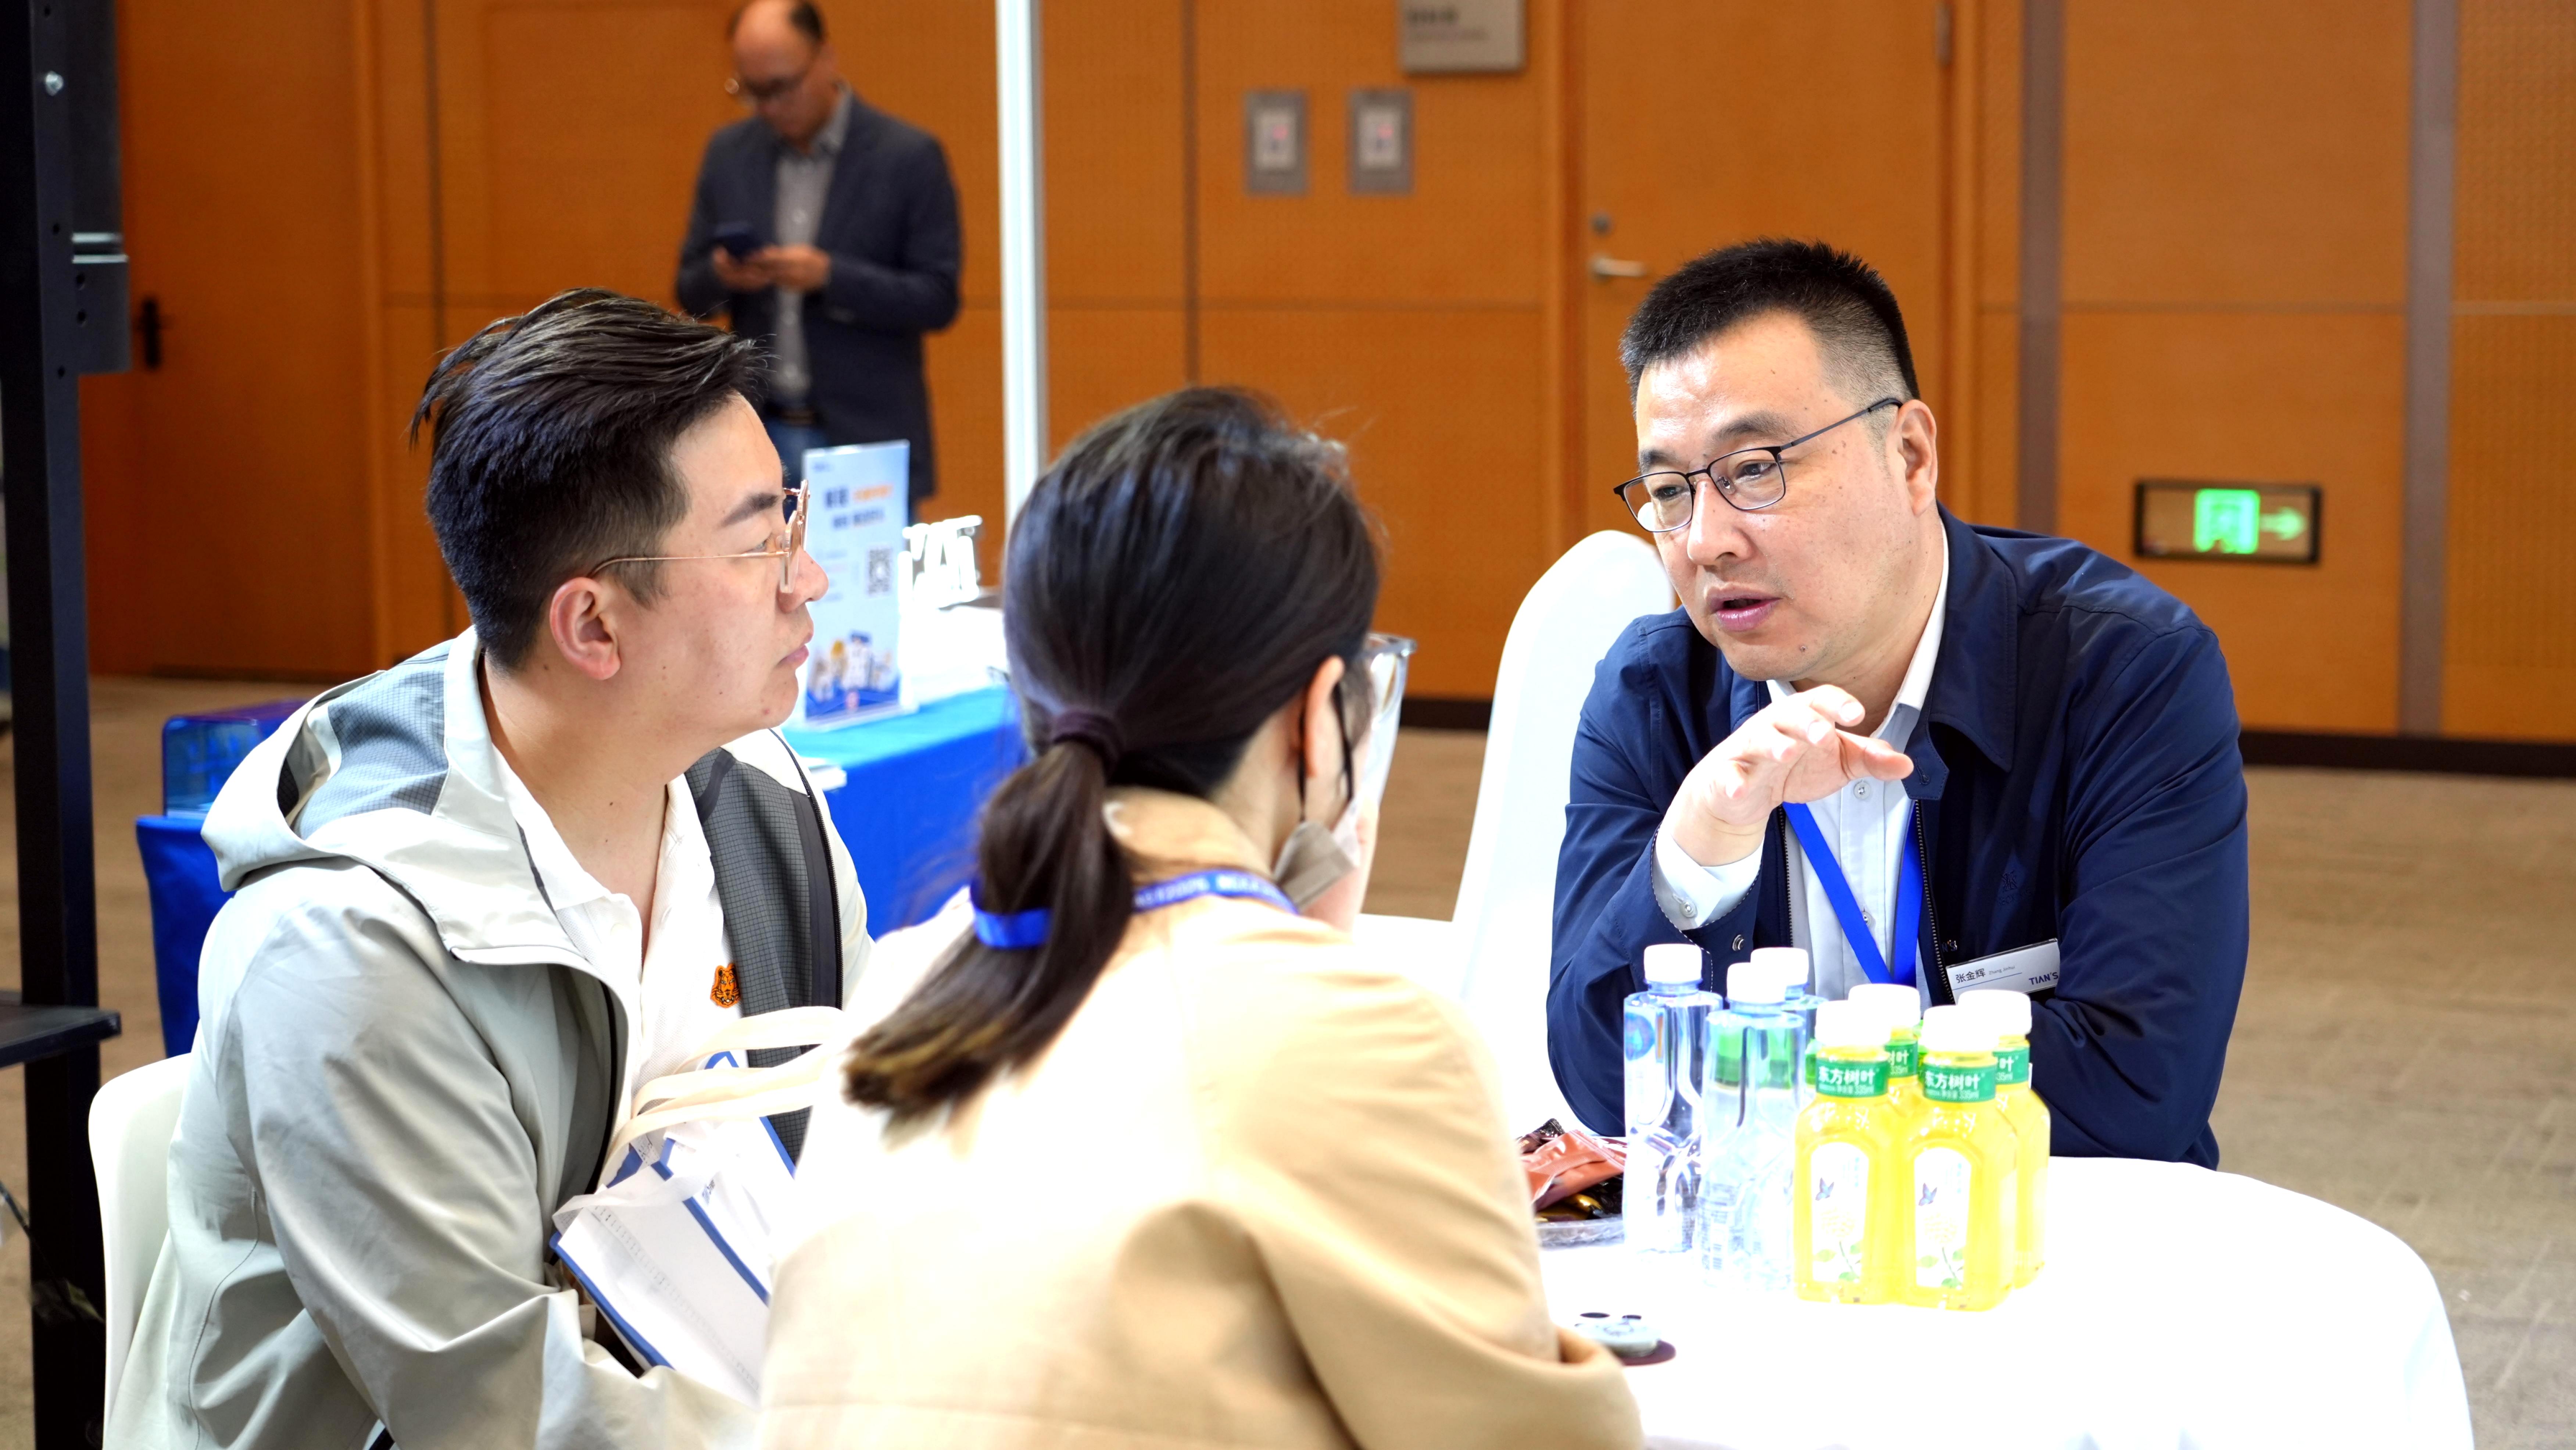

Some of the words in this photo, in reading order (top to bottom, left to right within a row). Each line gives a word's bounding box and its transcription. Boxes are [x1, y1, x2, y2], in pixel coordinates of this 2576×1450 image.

[1956, 968, 1986, 983] 张金辉
[2029, 972, 2058, 985] TIAN'S
[1819, 1066, 1875, 1085] 东方树叶
[1925, 1071, 1980, 1090] 东方树叶
